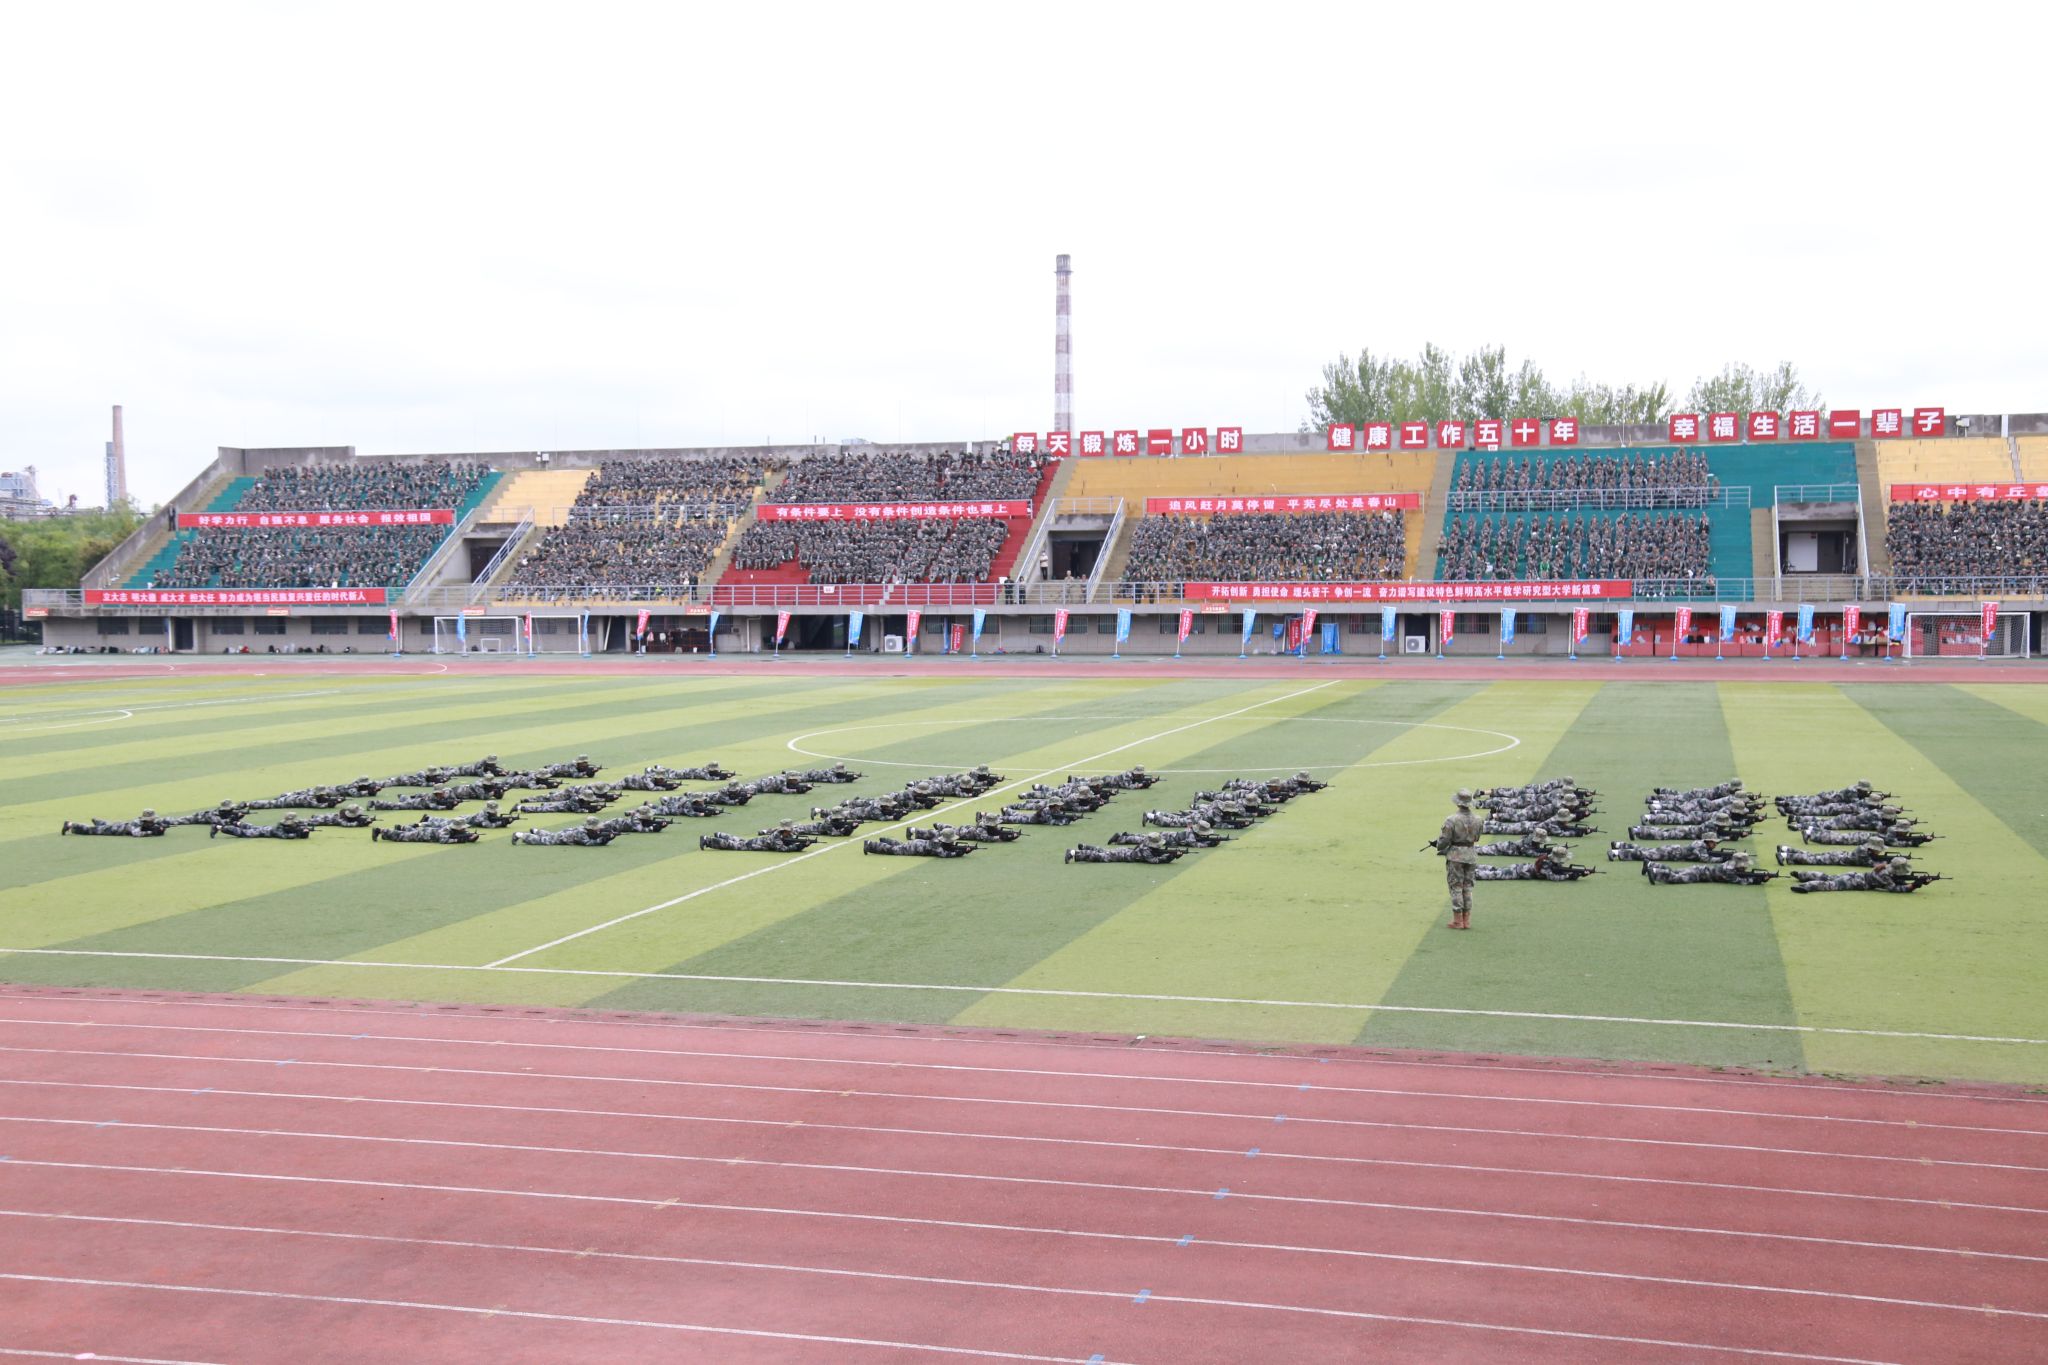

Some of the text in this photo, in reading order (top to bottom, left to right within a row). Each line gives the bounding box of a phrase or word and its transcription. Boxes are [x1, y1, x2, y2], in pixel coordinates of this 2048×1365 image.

[1016, 411, 1941, 453] 每天锻炼一小时 健康工作五十年 幸福生活一辈子
[776, 504, 1008, 518] 有条件要上 没有条件创造条件也要上
[1211, 586, 1248, 597] 开拓创新
[1334, 586, 1372, 598] 争创一流
